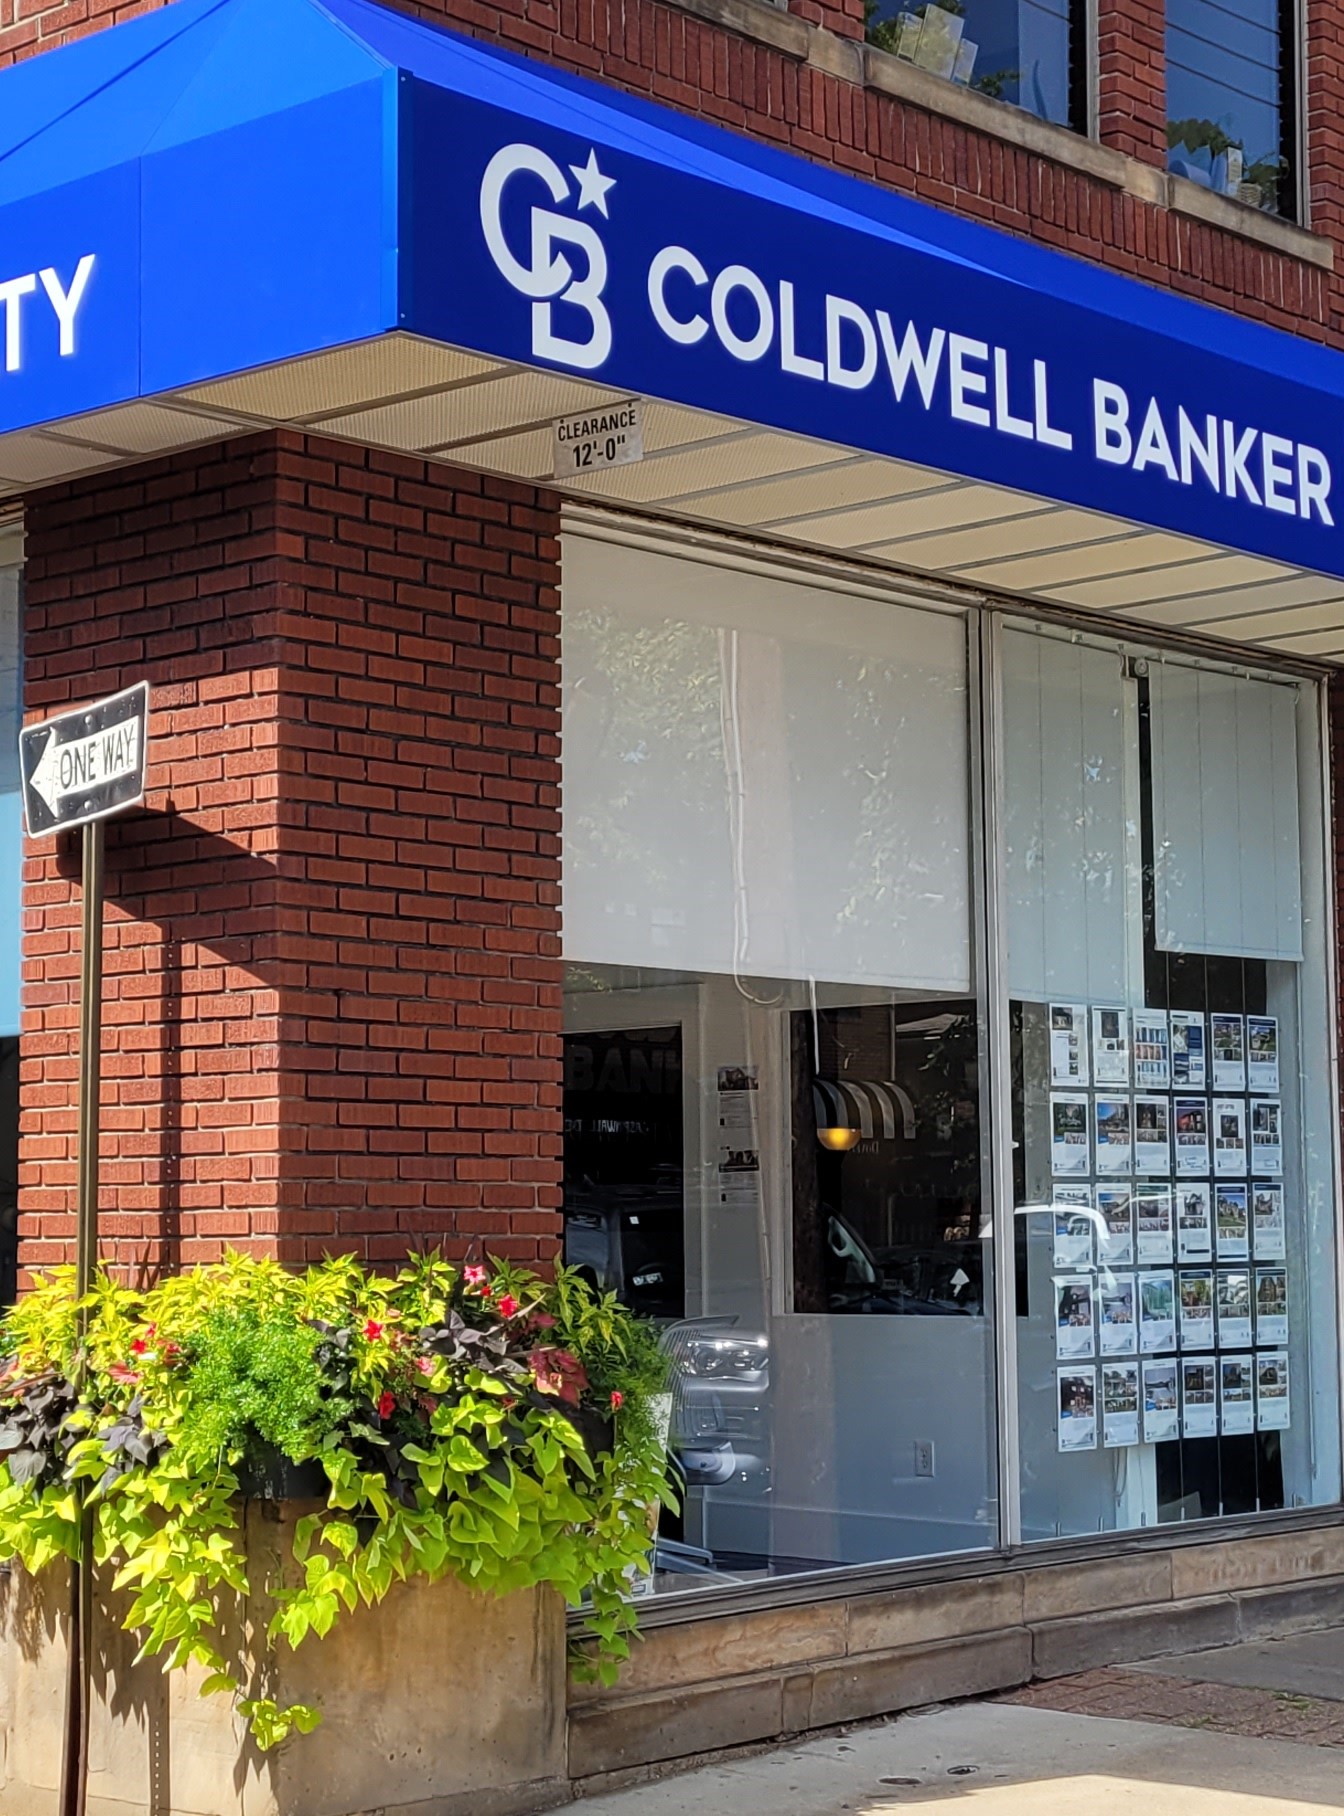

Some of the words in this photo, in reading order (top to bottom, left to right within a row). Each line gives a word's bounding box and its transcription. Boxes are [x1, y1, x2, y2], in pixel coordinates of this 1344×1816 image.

[648, 245, 1073, 451] COLDWELL
[1093, 377, 1334, 527] BANKER
[557, 409, 637, 442] CLEARANCE
[572, 434, 626, 468] 12'-0"
[59, 742, 97, 790] ONE
[101, 723, 135, 776] WAY
